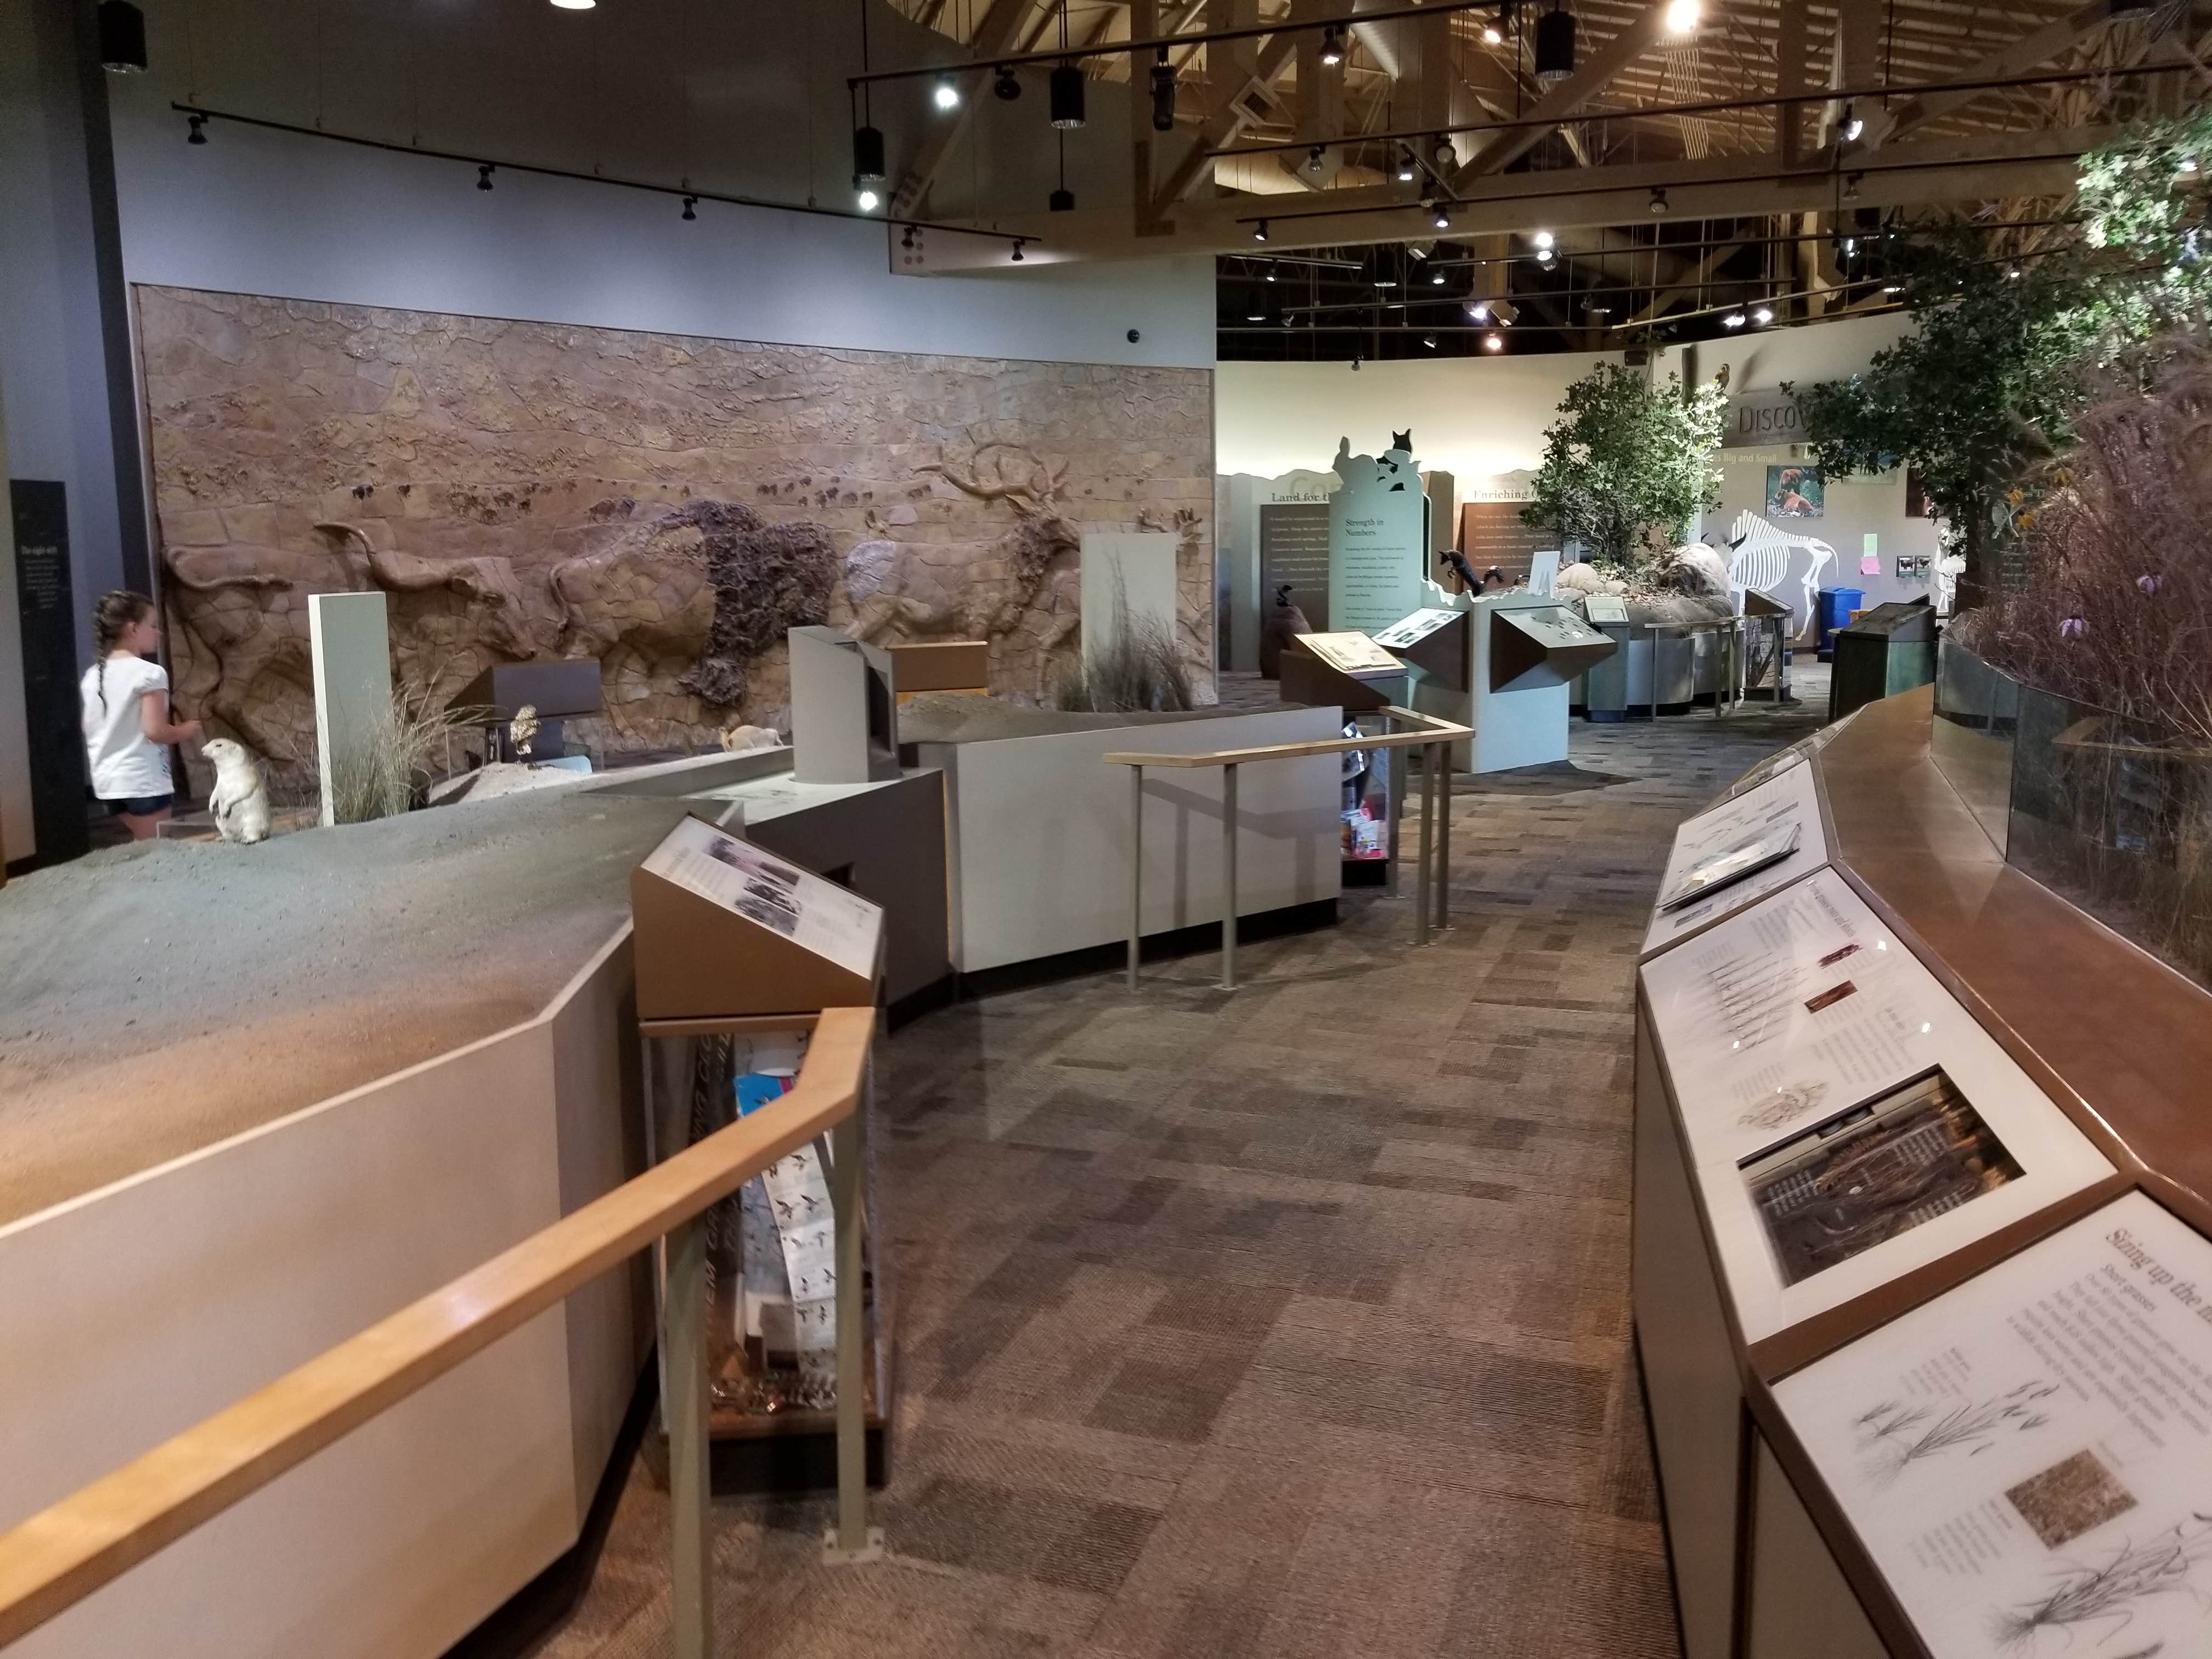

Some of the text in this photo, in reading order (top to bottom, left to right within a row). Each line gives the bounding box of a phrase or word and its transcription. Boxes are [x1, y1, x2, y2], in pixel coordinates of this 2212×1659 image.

[1724, 453, 1736, 464] Big
[1739, 454, 1754, 462] and
[1756, 454, 1777, 463] Small
[1271, 492, 1300, 502] Land
[1304, 492, 1320, 502] for
[1474, 490, 1529, 500] Enriching
[1345, 518, 1375, 527] Strength
[2105, 1228, 2154, 1271] Sizing
[2147, 1263, 2174, 1286] up
[2170, 1278, 2202, 1307] the
[2119, 1284, 2157, 1313] grasses
